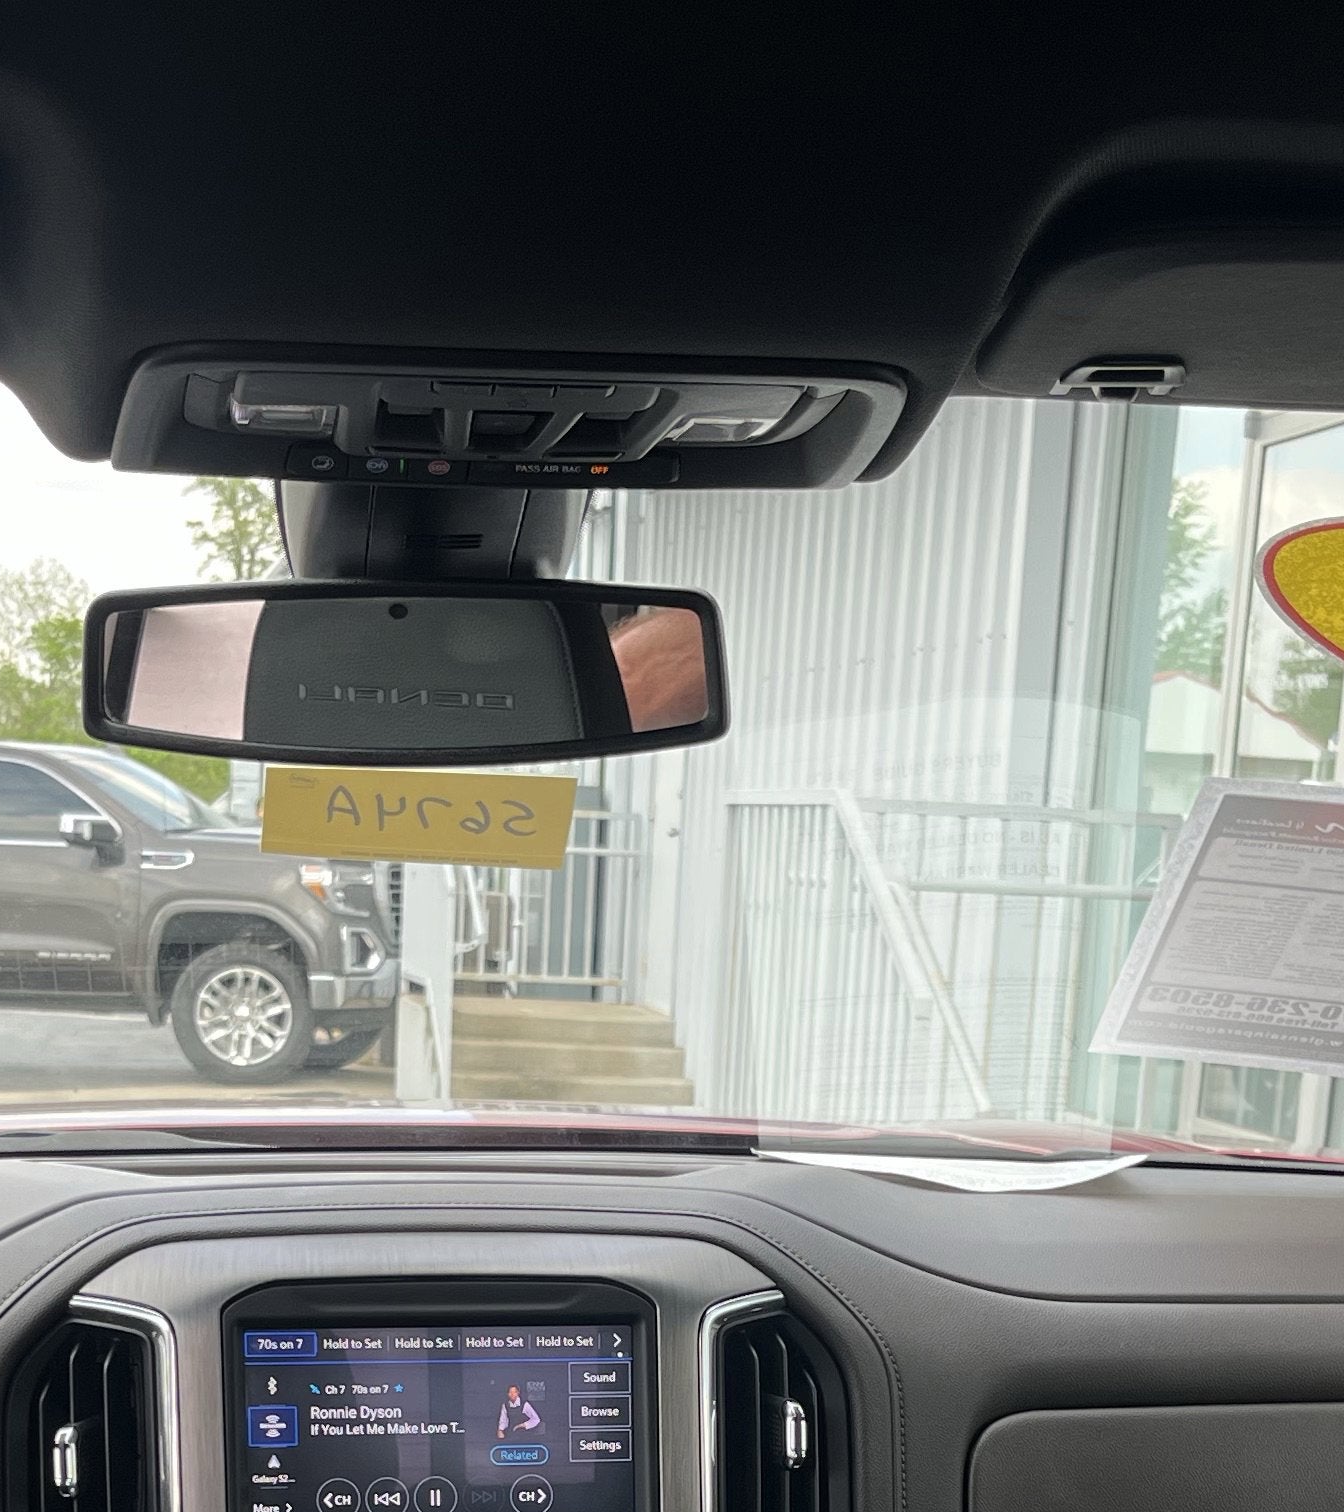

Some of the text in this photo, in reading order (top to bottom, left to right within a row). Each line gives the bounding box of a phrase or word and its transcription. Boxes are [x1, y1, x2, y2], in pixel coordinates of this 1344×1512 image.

[515, 464, 609, 475] PASS AIR BAG OFF
[257, 1338, 304, 1350] 70s on 7
[323, 1337, 383, 1350] Hold to Set
[394, 1337, 454, 1350] Hold to Set
[465, 1336, 524, 1348] Hold to Set
[536, 1335, 594, 1348] Hold to Set
[583, 1371, 616, 1383] Sound
[325, 1384, 389, 1395] Ch 7 70s on 7
[310, 1406, 402, 1421] Ronnie Dyson
[581, 1405, 620, 1417] Browse
[310, 1424, 319, 1436] If
[321, 1423, 344, 1436] You
[346, 1423, 365, 1435] Let
[367, 1423, 385, 1435] Me
[387, 1422, 419, 1435] Make
[421, 1422, 448, 1434] Love
[579, 1440, 622, 1453] Settings
[500, 1449, 538, 1461] Related
[252, 1474, 278, 1485] Galaxy
[334, 1494, 352, 1506] CH
[518, 1491, 535, 1502] CH
